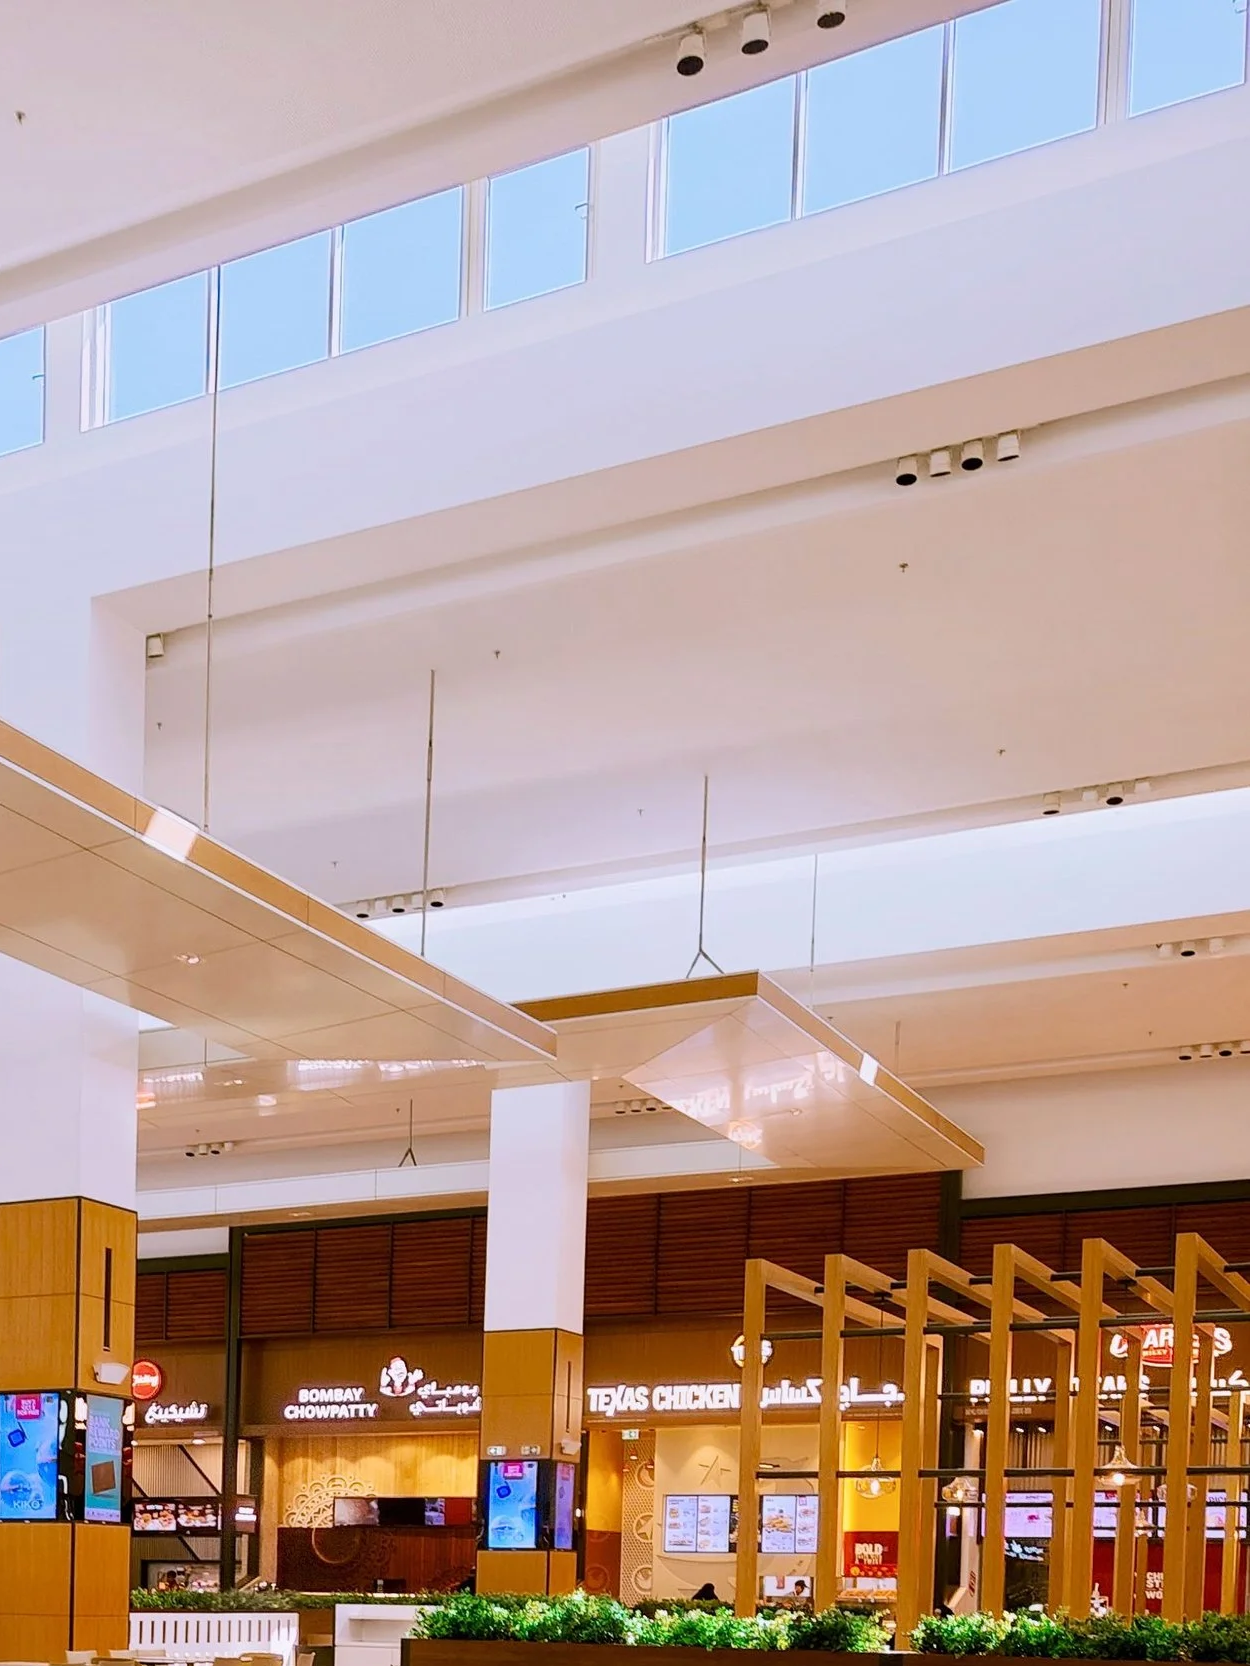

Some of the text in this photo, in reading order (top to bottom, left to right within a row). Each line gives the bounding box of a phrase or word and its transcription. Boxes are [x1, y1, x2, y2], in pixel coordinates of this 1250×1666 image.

[298, 1387, 365, 1403] BOMBAY
[587, 1383, 741, 1416] TEXAS CHICKEN
[284, 1403, 378, 1420] CHOWPATTY
[13, 1500, 40, 1510] KIKO
